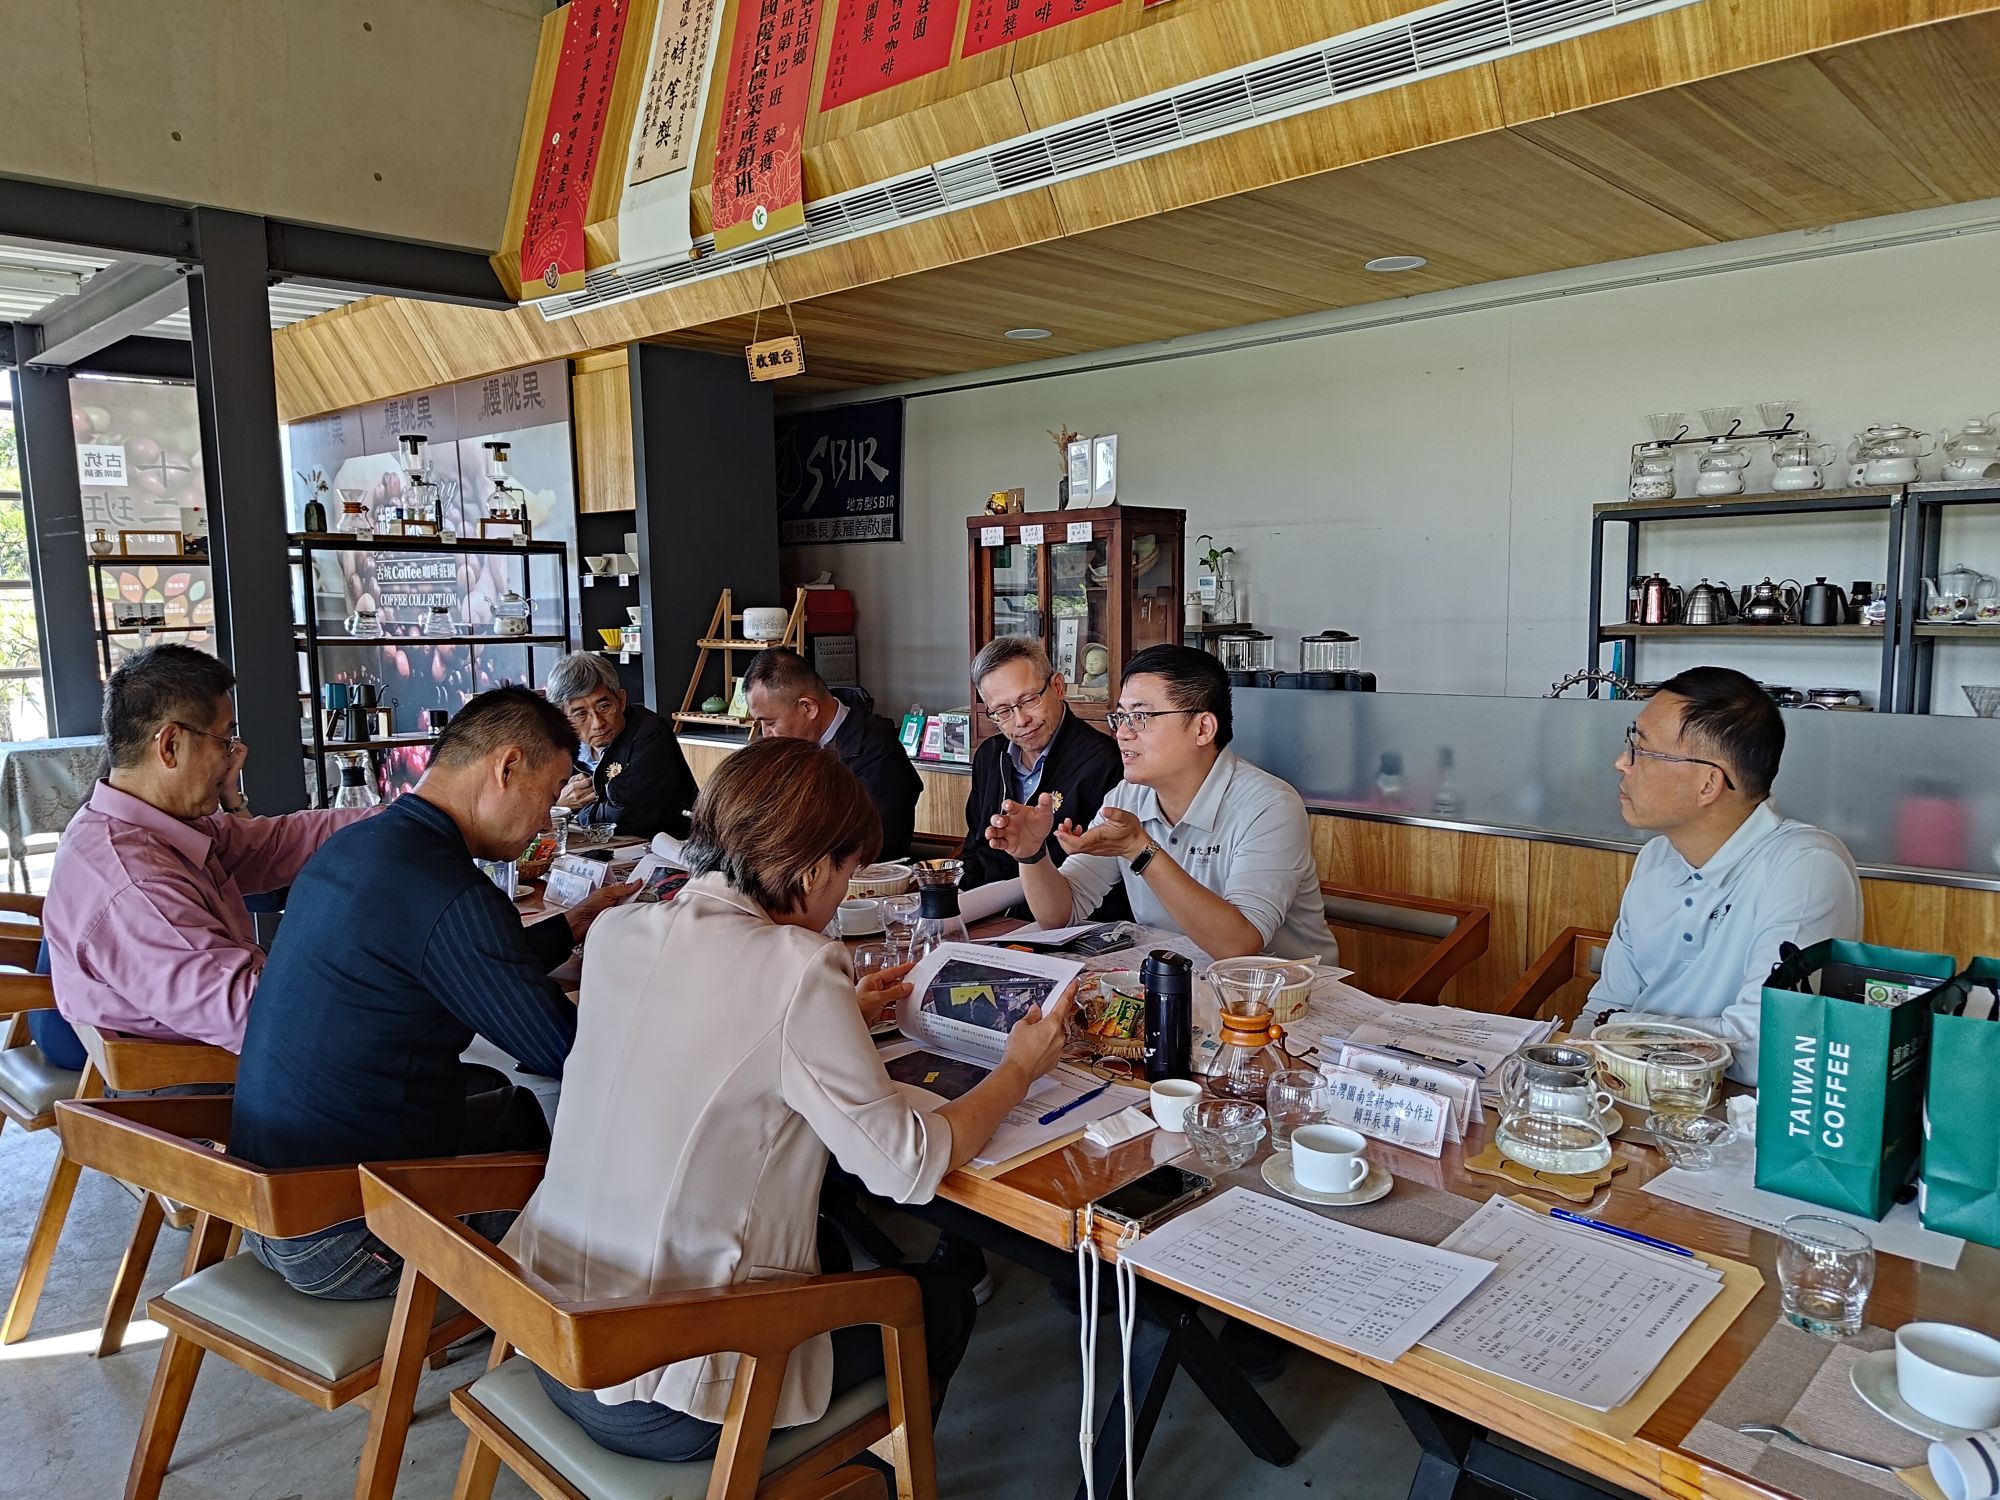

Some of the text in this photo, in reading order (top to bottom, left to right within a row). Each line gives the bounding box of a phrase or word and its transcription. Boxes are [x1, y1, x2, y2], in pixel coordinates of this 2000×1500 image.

[756, 348, 794, 369] 收銀台
[481, 371, 544, 420] 櫻桃果
[801, 435, 890, 512] SBIR
[846, 495, 895, 511] 地方型SBIR
[380, 593, 457, 606] COFFEE COLLECTION
[1789, 1035, 1817, 1138] TAIWAN
[1822, 1041, 1850, 1149] COFFEE
